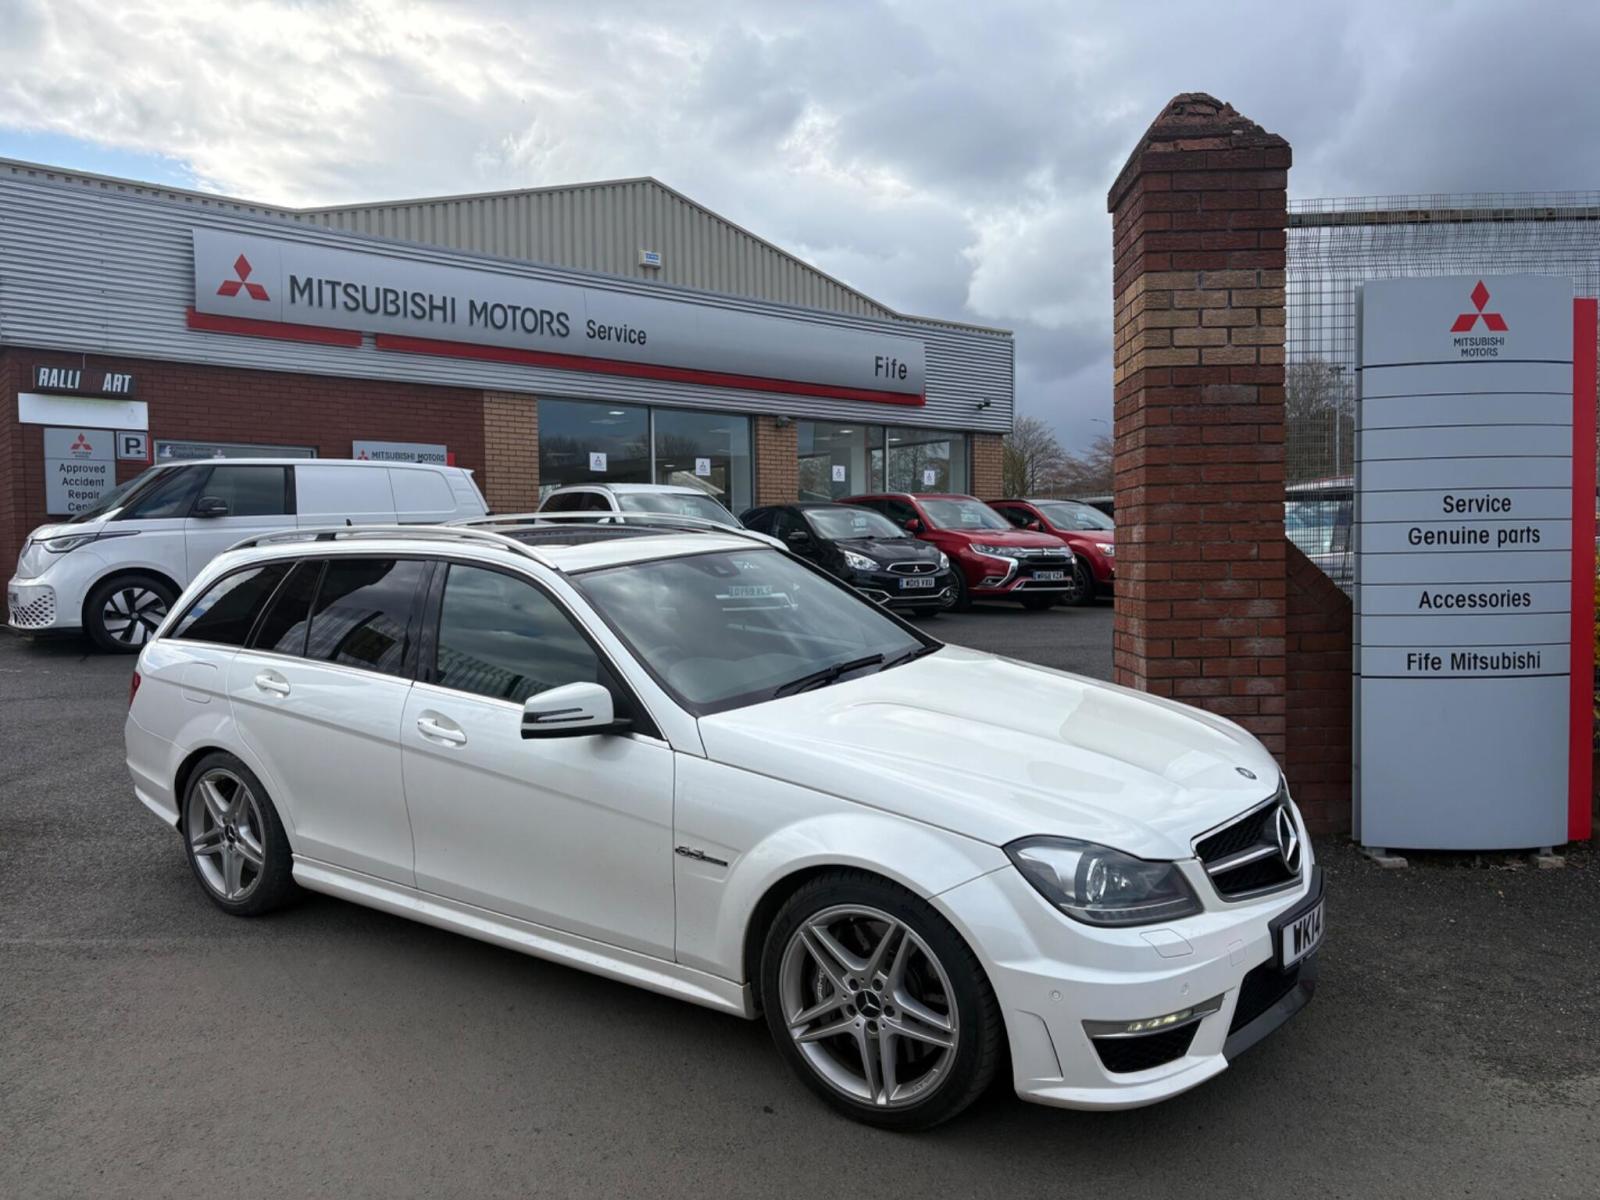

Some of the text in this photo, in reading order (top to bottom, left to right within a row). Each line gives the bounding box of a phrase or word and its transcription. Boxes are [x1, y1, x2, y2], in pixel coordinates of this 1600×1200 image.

[289, 274, 648, 346] MITSUBISHI MOTORS Service
[1453, 336, 1505, 347] MITSUBISHI
[1461, 347, 1498, 357] MOTORS
[875, 355, 908, 380] Fife
[38, 367, 132, 393] RALLI ART
[59, 463, 106, 475] Approved
[62, 477, 105, 487] Accident
[68, 489, 100, 501] Repair
[1443, 494, 1512, 514] Service
[1408, 526, 1541, 548] Genuine parts
[1418, 589, 1531, 609] Accessories
[1406, 651, 1541, 671] Fife Mitsubishi
[1293, 905, 1321, 955] WK14
